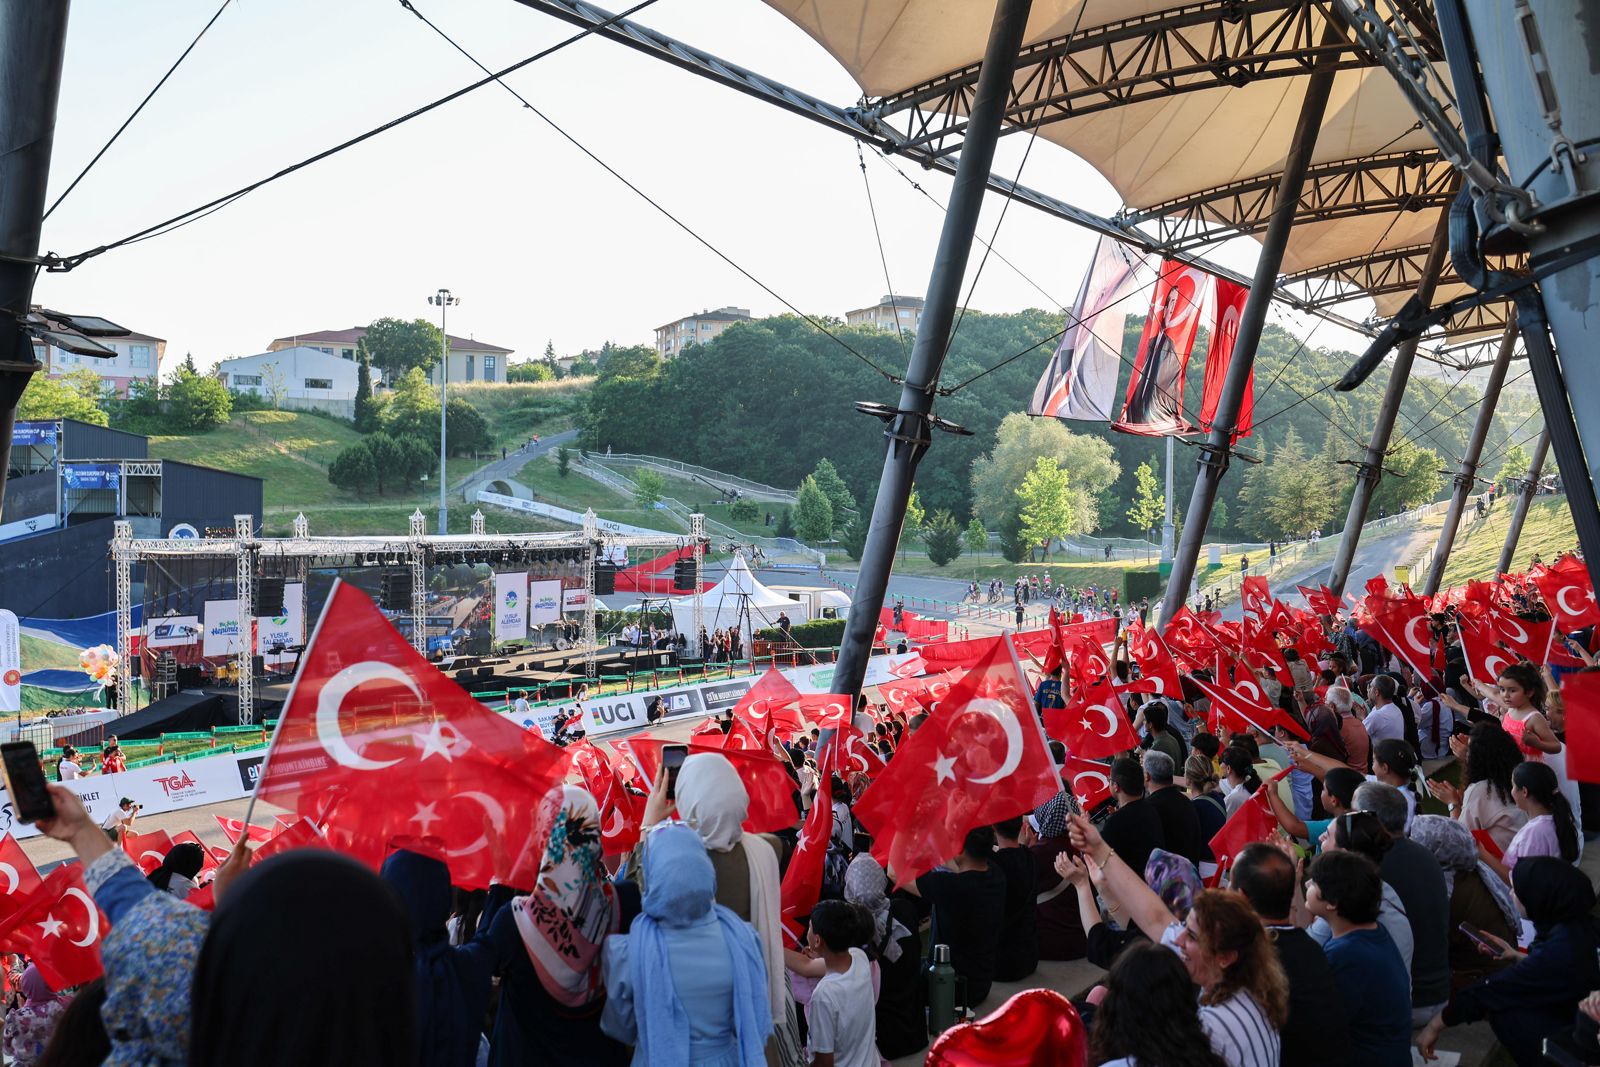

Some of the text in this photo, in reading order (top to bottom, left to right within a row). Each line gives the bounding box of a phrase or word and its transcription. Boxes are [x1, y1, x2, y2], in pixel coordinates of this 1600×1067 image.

[204, 526, 238, 534] SAKARY
[606, 522, 620, 531] UCI
[598, 702, 636, 724] UCI
[152, 769, 196, 797] TGA
[79, 791, 100, 802] İKLET
